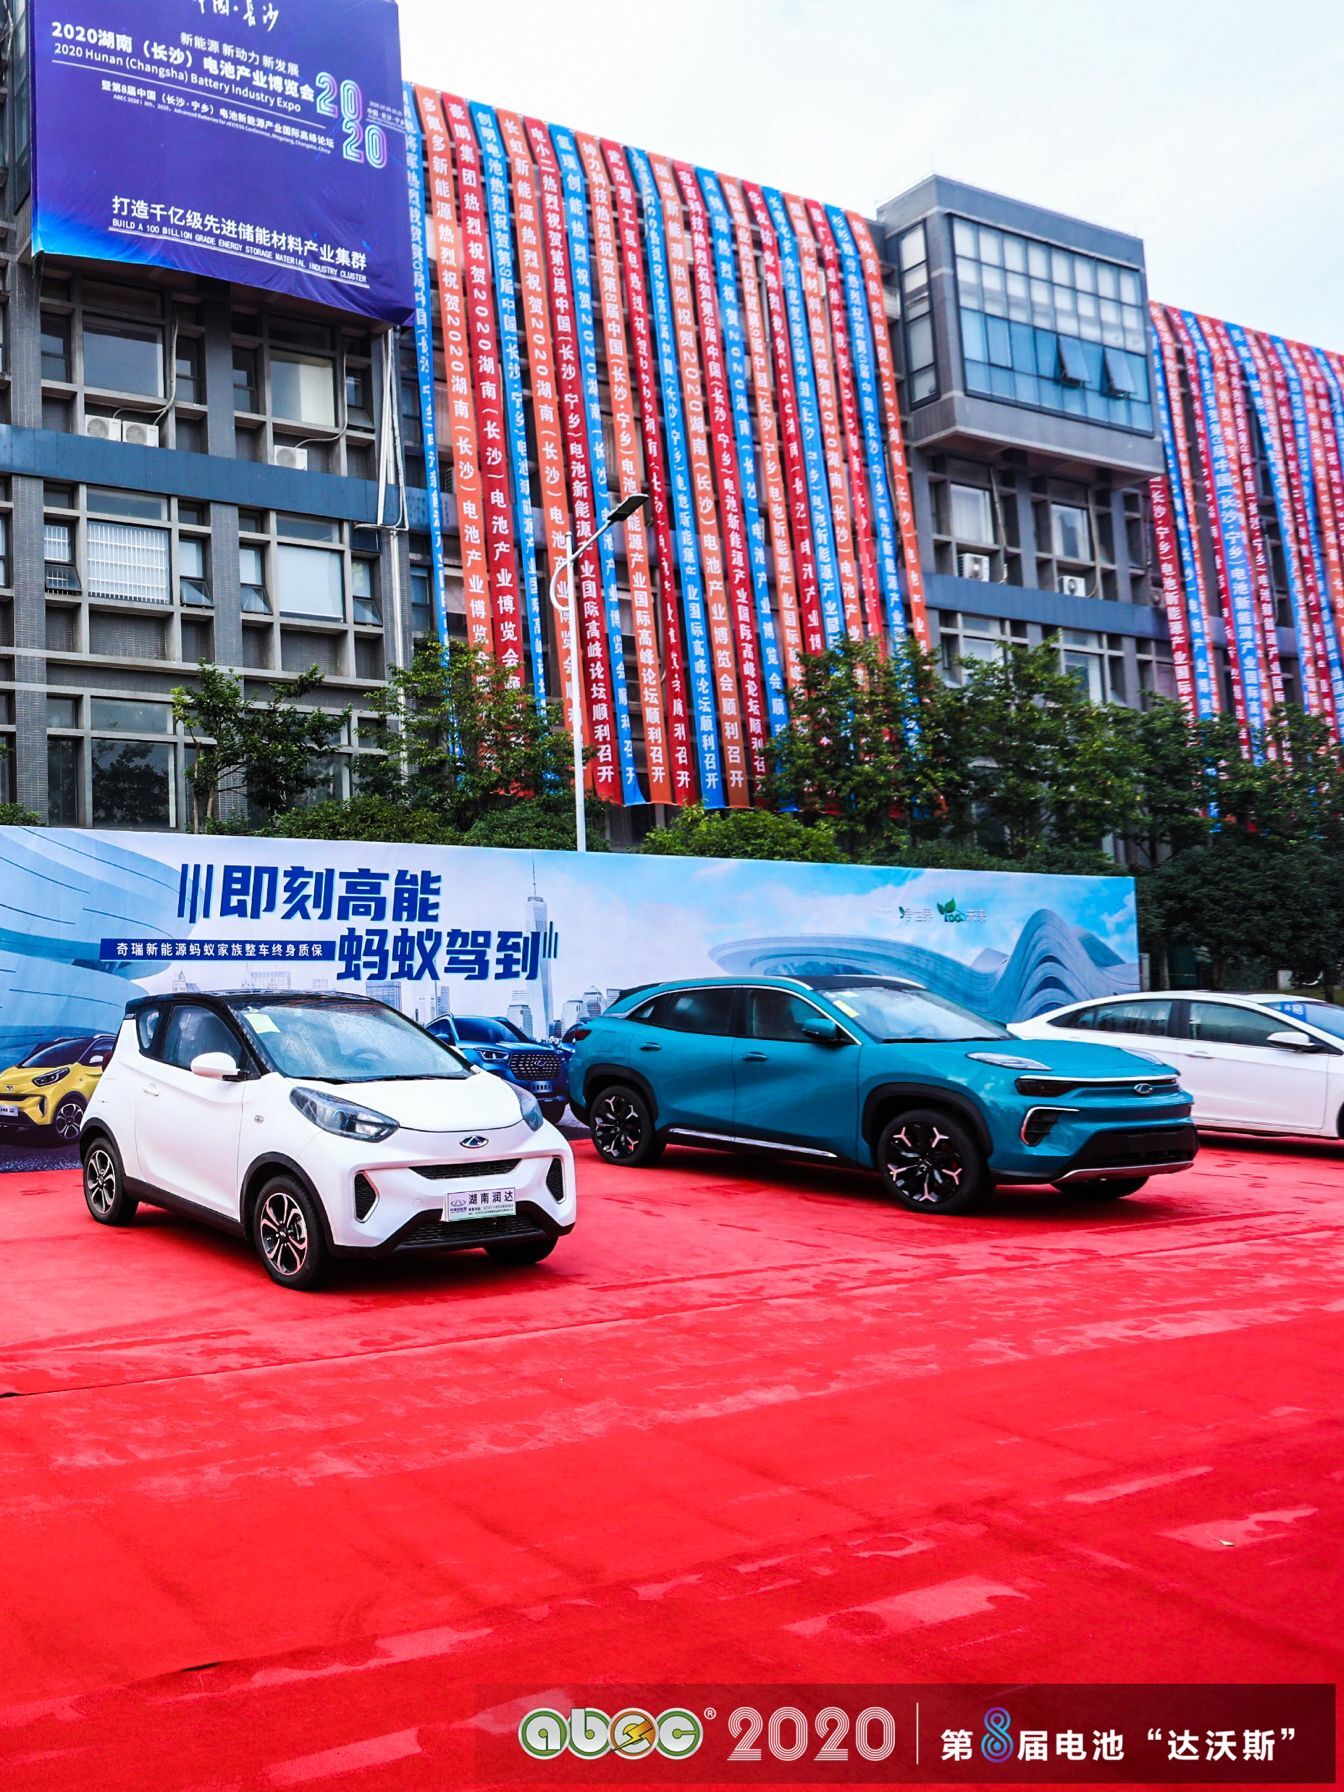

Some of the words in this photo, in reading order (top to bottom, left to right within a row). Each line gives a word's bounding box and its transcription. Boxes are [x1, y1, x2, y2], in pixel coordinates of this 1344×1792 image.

[51, 22, 315, 103] 2020湖南（长沙）电池产业博览会
[54, 43, 83, 58] 2020
[85, 49, 123, 66] Hunan
[126, 57, 188, 82] (Changsha)
[190, 73, 230, 94] Battery
[232, 83, 276, 107] Industry
[277, 97, 302, 113] Expo
[180, 31, 220, 54] 新能源
[222, 42, 260, 65] 新动力
[262, 54, 299, 77] 新发展
[112, 195, 367, 272] 打造千亿级先进储能材料产业集群
[112, 218, 135, 230] BUILD
[137, 222, 144, 231] A
[146, 224, 159, 234] 100
[162, 226, 193, 240] BILLION
[195, 234, 216, 246] GRADE
[218, 238, 243, 252] ENERGY
[245, 245, 273, 259] STORAGE
[275, 253, 306, 268] MATERIAL
[308, 262, 338, 276] INDUSTRY
[340, 270, 367, 283] CLUSTER
[449, 103, 524, 770] 豪鹏集团热烈祝贺2020湖南（长沙）电池产业博览会顺
[582, 141, 666, 783] 神力科技热烈祝贺第8届中国（长沙·宁乡）电池能源产业国际高峰论坛顺利召开
[220, 864, 443, 924] 即刻高能
[116, 942, 324, 958] 奇瑞新能源蚂蚁家族整车终身质保
[336, 927, 542, 982] 蚂蚁驾到
[468, 1190, 514, 1205] 湖南润达
